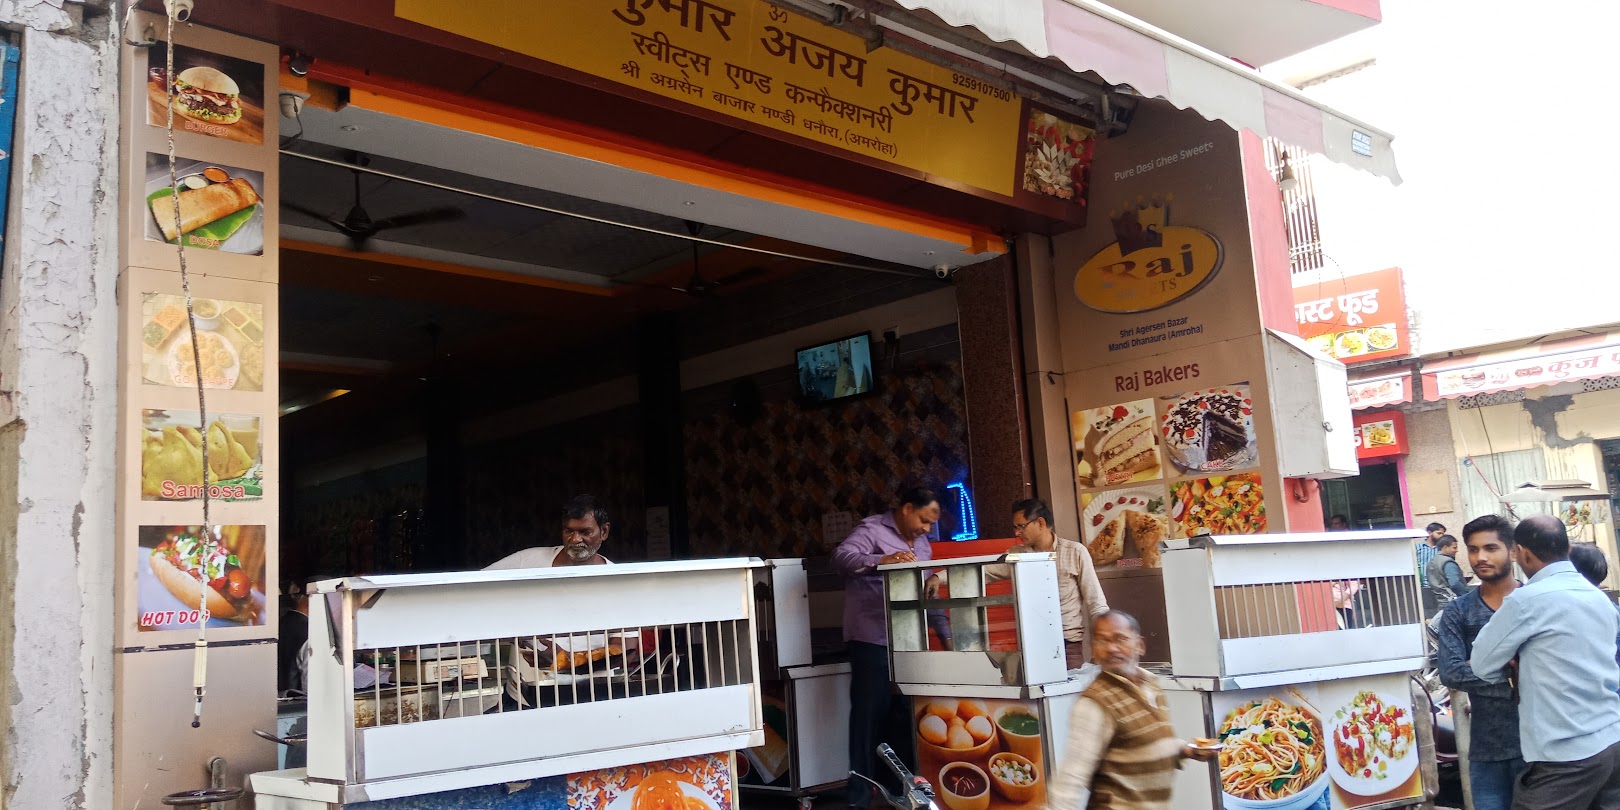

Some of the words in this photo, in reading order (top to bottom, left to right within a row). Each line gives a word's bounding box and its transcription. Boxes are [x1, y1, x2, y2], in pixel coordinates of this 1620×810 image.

[630, 31, 712, 78] स्वीट्स
[724, 62, 772, 94] एण्ड
[760, 25, 867, 87] अजय
[887, 68, 978, 123] कुमार
[620, 60, 641, 79] श्री
[650, 72, 704, 98] अग्रसेन
[712, 90, 756, 113] बाजार
[760, 105, 795, 126] मण्डी
[951, 72, 1011, 103] 9259107500
[184, 120, 229, 137] BURGER
[1114, 167, 1135, 181] Pure
[1136, 160, 1154, 175] Desi
[1155, 153, 1178, 168] Ghee
[1179, 142, 1213, 160] Sweets
[189, 235, 220, 248] DOSA
[1096, 244, 1194, 281] Raj
[1294, 298, 1335, 324] ास्ट
[1337, 288, 1380, 326] फूड
[1109, 340, 1130, 352] Mandi
[1131, 333, 1167, 348] Dhanaura
[1168, 324, 1203, 340] (Amroha)
[1119, 328, 1134, 339] Shri
[1135, 321, 1166, 335] Agersen
[1167, 316, 1188, 328] Bazar
[1115, 371, 1140, 393] Raj
[1143, 363, 1200, 387] Bakers
[161, 480, 245, 499] Samosa
[142, 610, 174, 626] HOT
